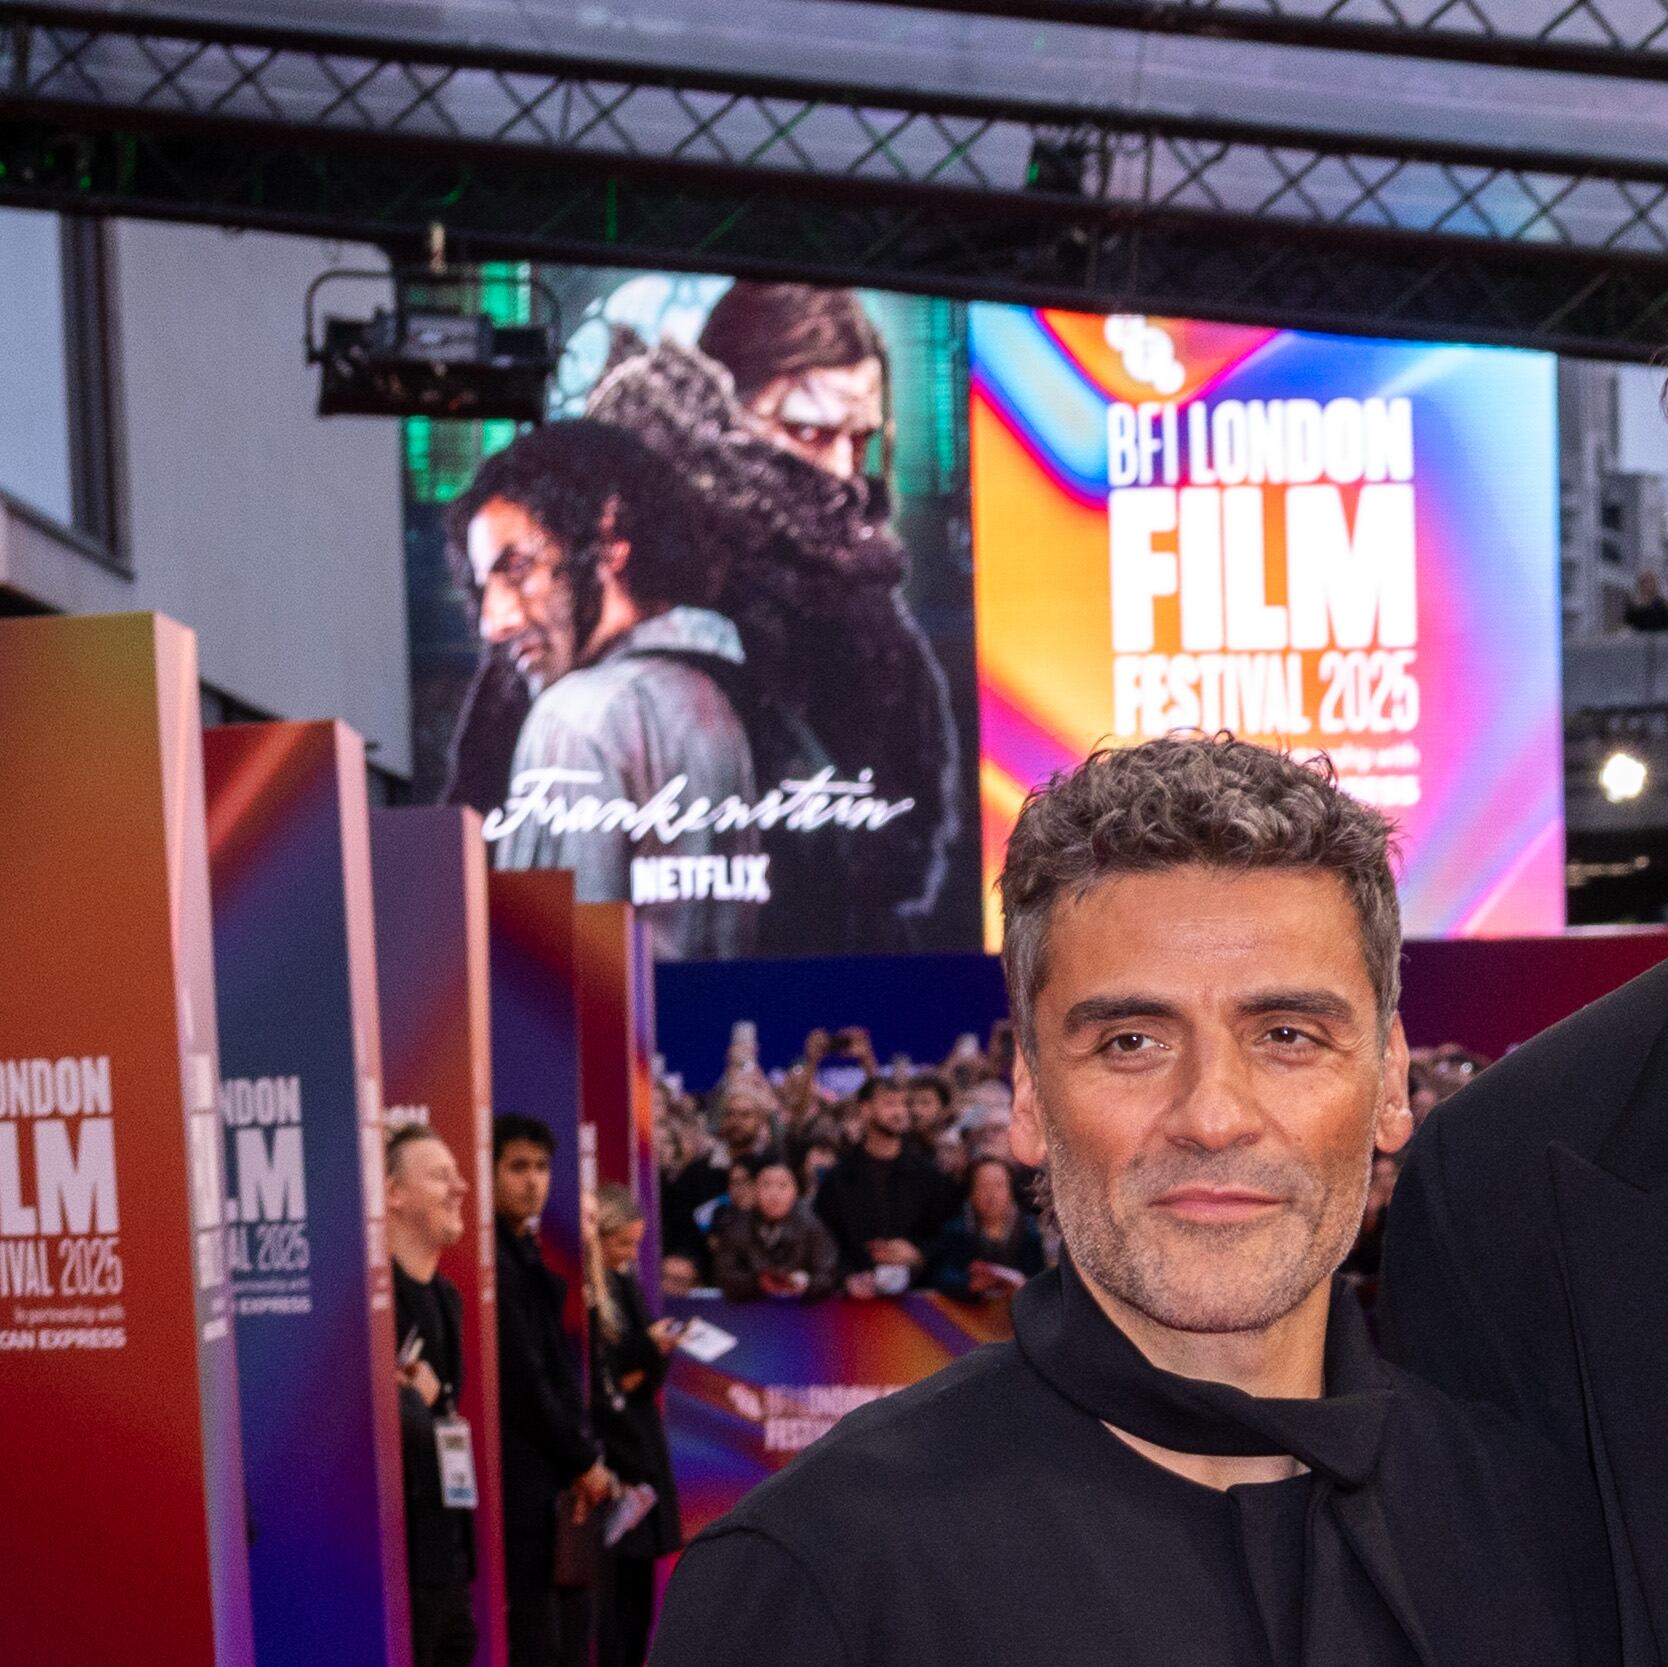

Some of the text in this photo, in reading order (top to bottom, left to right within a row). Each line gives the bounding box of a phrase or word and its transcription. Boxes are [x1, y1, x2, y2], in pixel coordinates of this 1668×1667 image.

[1107, 398, 1414, 487] BFI LONDON
[1108, 484, 1417, 652] FILM
[1112, 651, 1420, 737] FESTIVAL 2025
[481, 765, 915, 843] Frankenstein
[631, 853, 771, 903] NETFLIX
[58, 1236, 123, 1297] 2025
